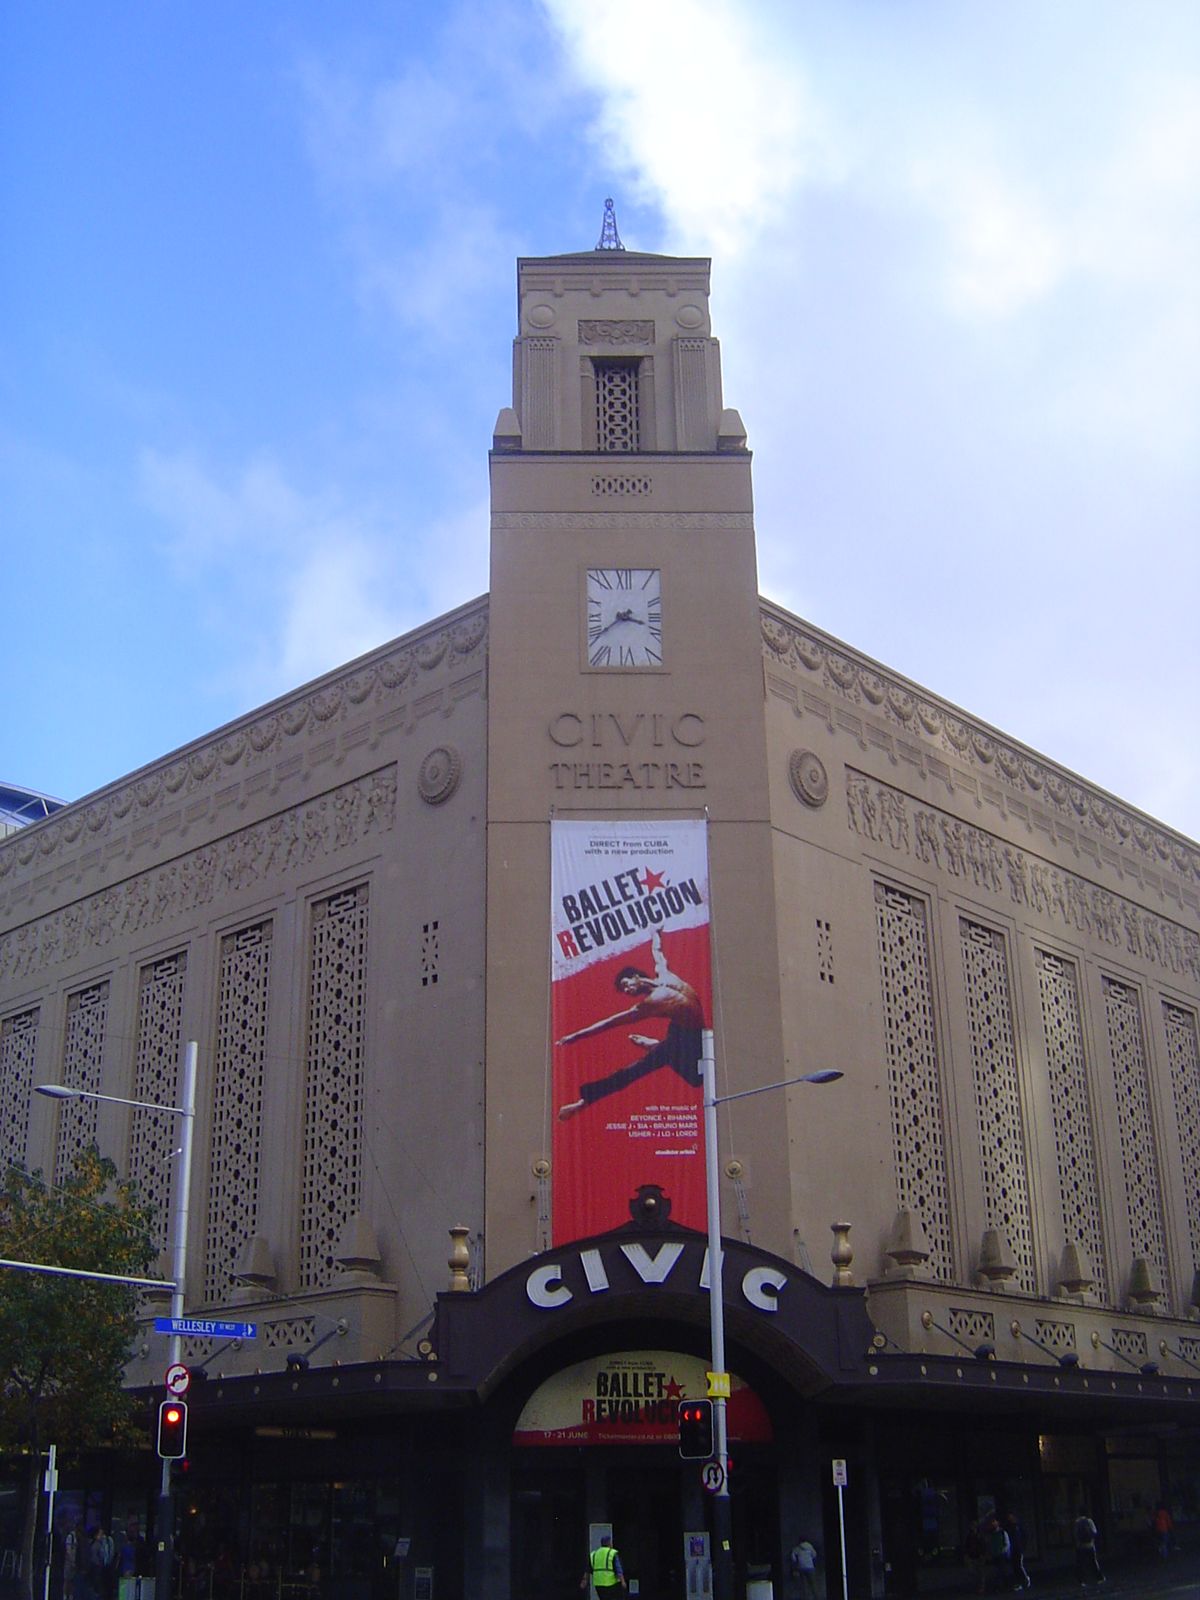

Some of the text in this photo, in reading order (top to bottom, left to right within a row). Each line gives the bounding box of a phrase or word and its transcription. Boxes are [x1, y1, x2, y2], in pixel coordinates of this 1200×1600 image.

[549, 713, 705, 748] CIVIC
[550, 763, 706, 789] THEATRE
[630, 850, 674, 858] production
[562, 868, 644, 924] BALLET
[556, 878, 703, 960] REVOLUCIÓN
[526, 1243, 787, 1311] CIVIC
[171, 1319, 216, 1333] WELLESLEY
[596, 1372, 666, 1397] BALLET
[567, 1431, 588, 1439] JUNE
